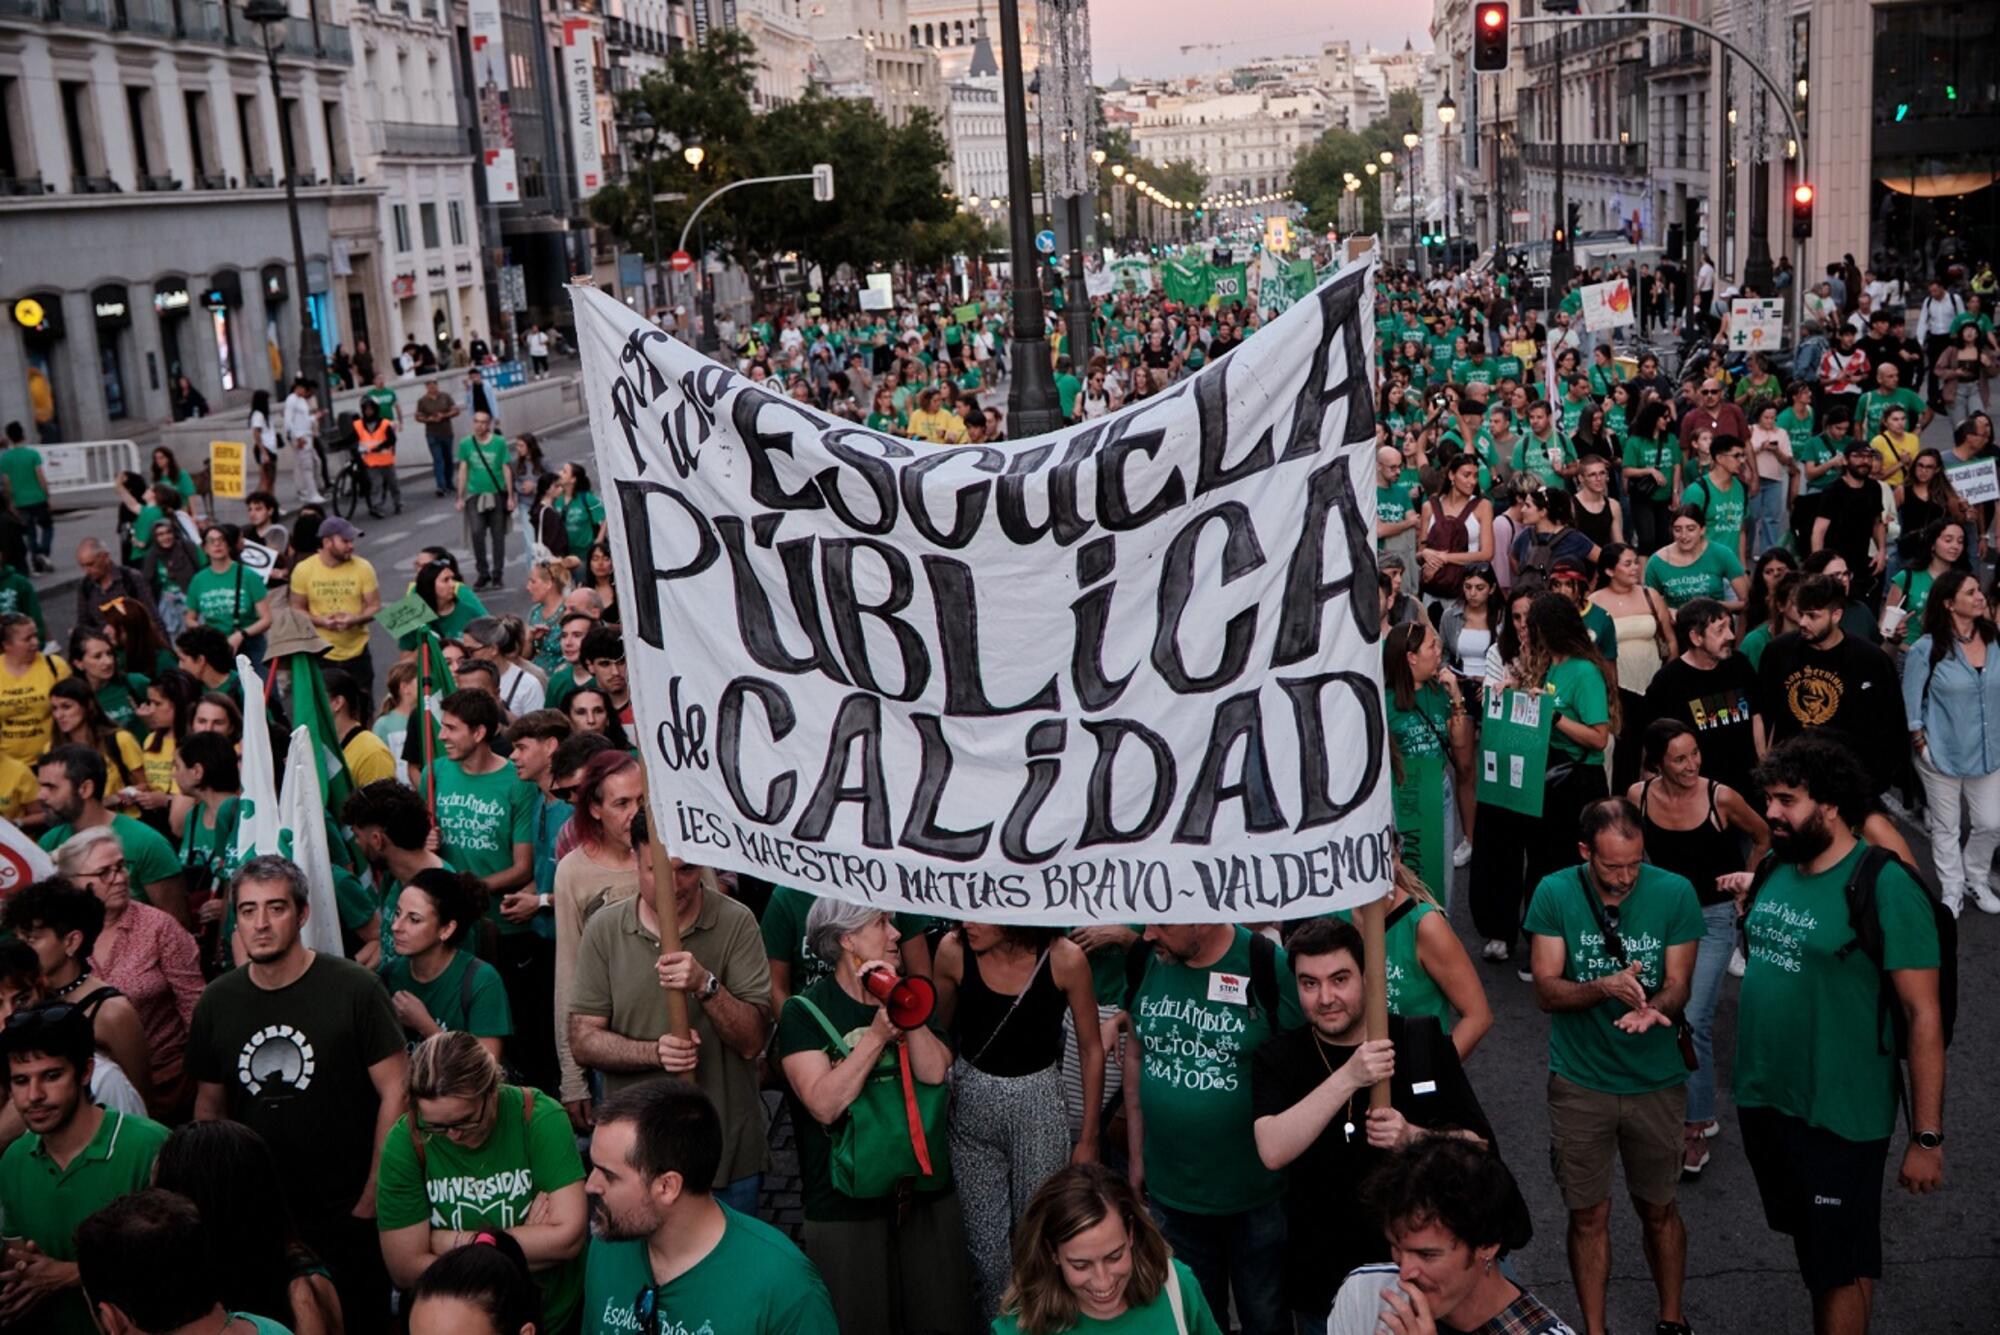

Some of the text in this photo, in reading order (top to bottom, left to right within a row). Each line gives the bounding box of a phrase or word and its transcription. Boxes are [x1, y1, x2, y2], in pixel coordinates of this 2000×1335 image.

[574, 58, 596, 162] Sala Alcalá 31
[1216, 280, 1237, 295] NO
[611, 328, 669, 477] por
[660, 363, 738, 480] una
[657, 675, 710, 772] de
[732, 822, 888, 901] MAESTRO
[1040, 858, 1173, 919] BRAVO
[1751, 924, 1798, 949] DE TOD@S
[1588, 958, 1604, 969] DE
[1219, 984, 1239, 993] STEM
[1140, 995, 1191, 1025] ESCUELA
[1144, 1036, 1230, 1063] DE TOD@S
[1172, 1066, 1239, 1092] TOD@S
